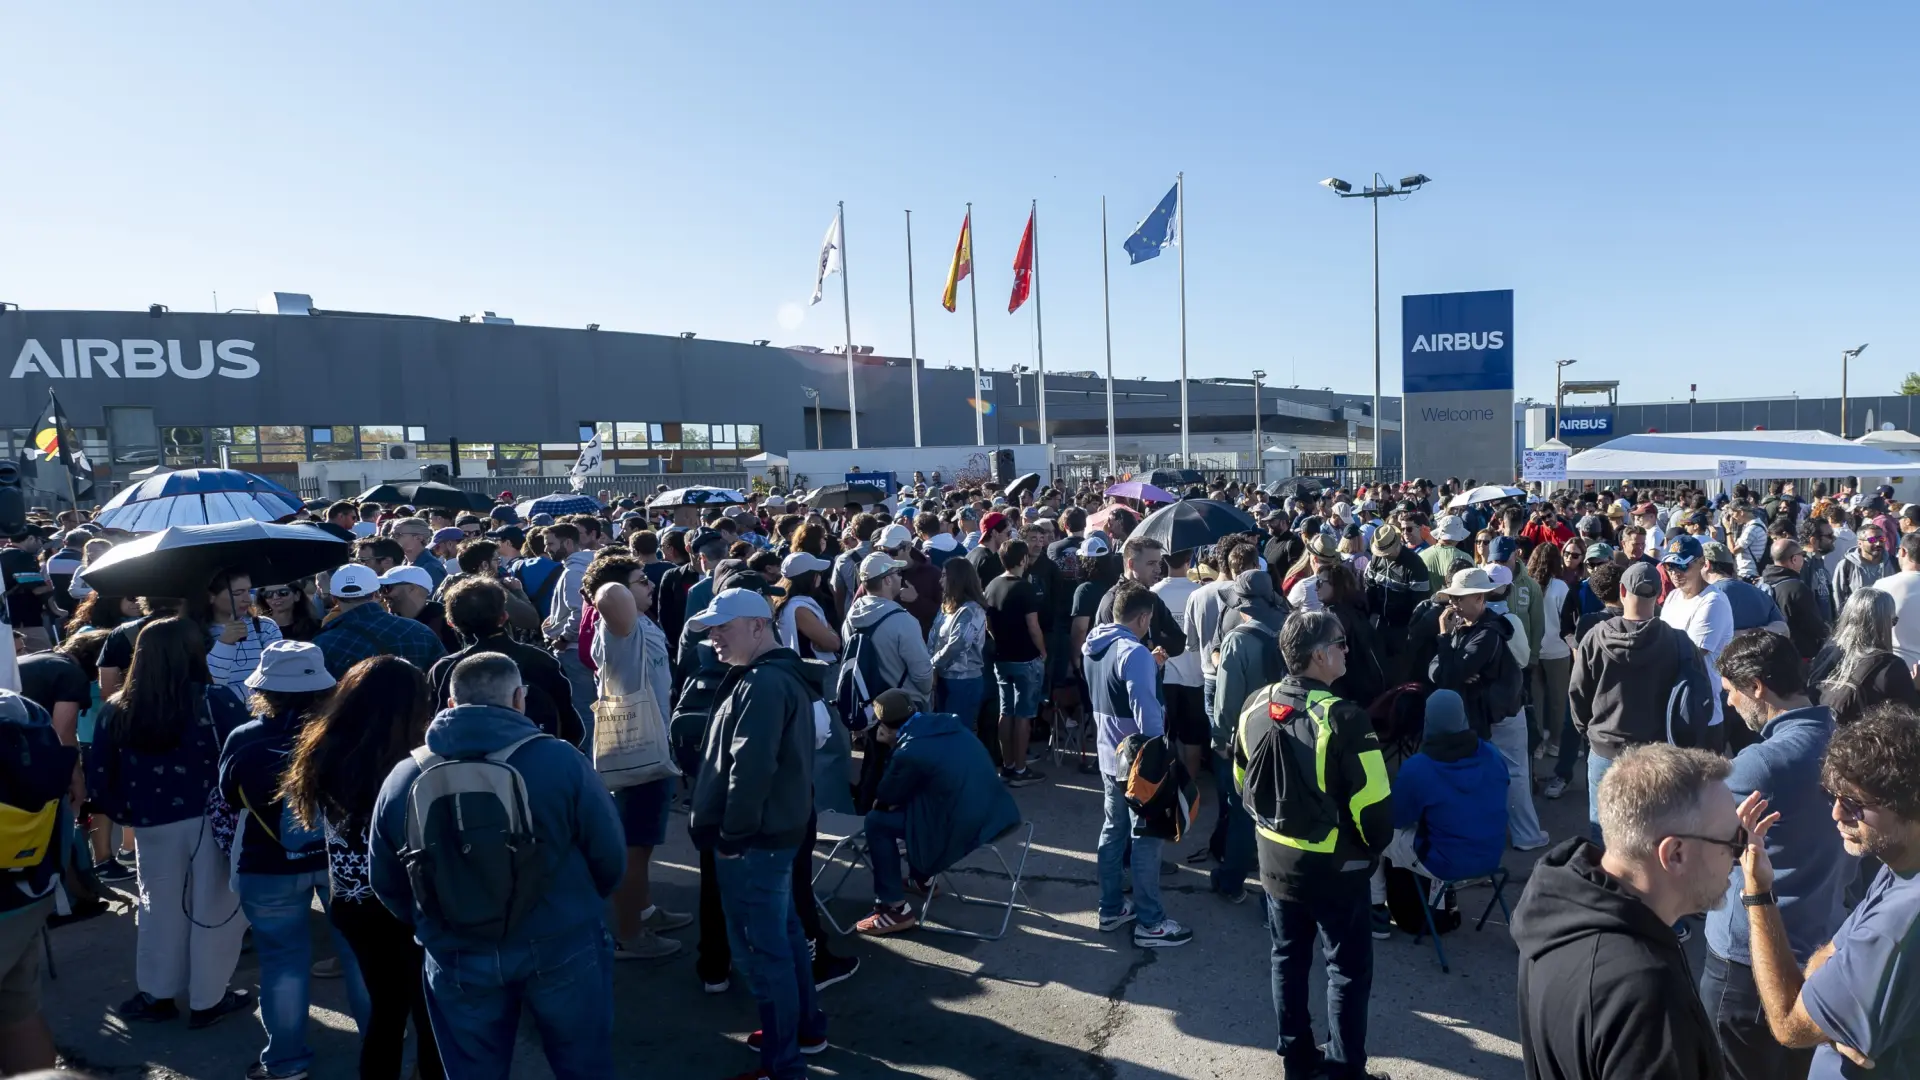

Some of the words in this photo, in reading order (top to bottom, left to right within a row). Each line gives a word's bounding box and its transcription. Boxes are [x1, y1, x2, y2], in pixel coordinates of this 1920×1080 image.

[1411, 330, 1504, 352] AIRBUS
[9, 338, 260, 380] AIRBUS
[980, 378, 991, 389] A1
[1421, 407, 1494, 422] Welcome
[1559, 418, 1607, 430] AIRBUS
[1518, 586, 1530, 605] S
[597, 711, 637, 723] morriña
